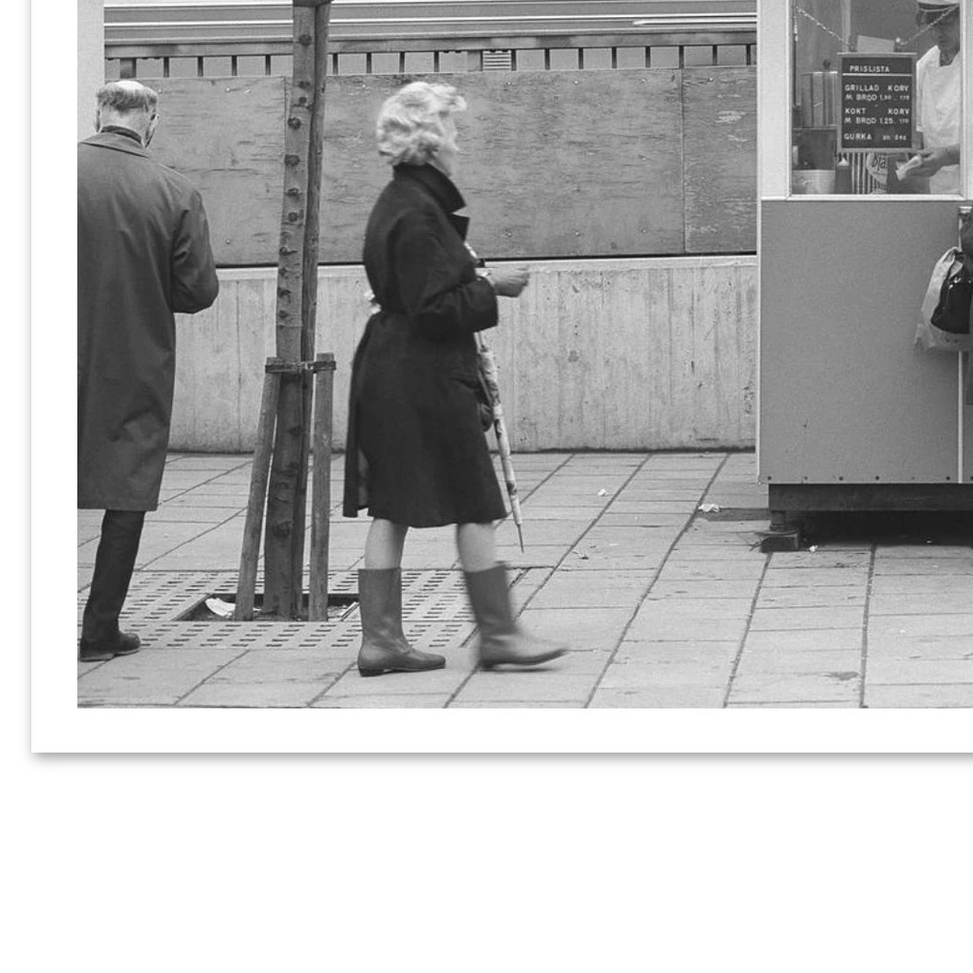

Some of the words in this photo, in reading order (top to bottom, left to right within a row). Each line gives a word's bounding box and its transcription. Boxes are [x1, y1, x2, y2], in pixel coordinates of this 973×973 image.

[849, 64, 890, 73] PRISLISTA
[844, 84, 880, 92] GRILLAD
[887, 84, 910, 92] KORV
[844, 107, 867, 115] KOKT
[887, 107, 910, 115] KORV
[843, 132, 872, 140] GURKA
